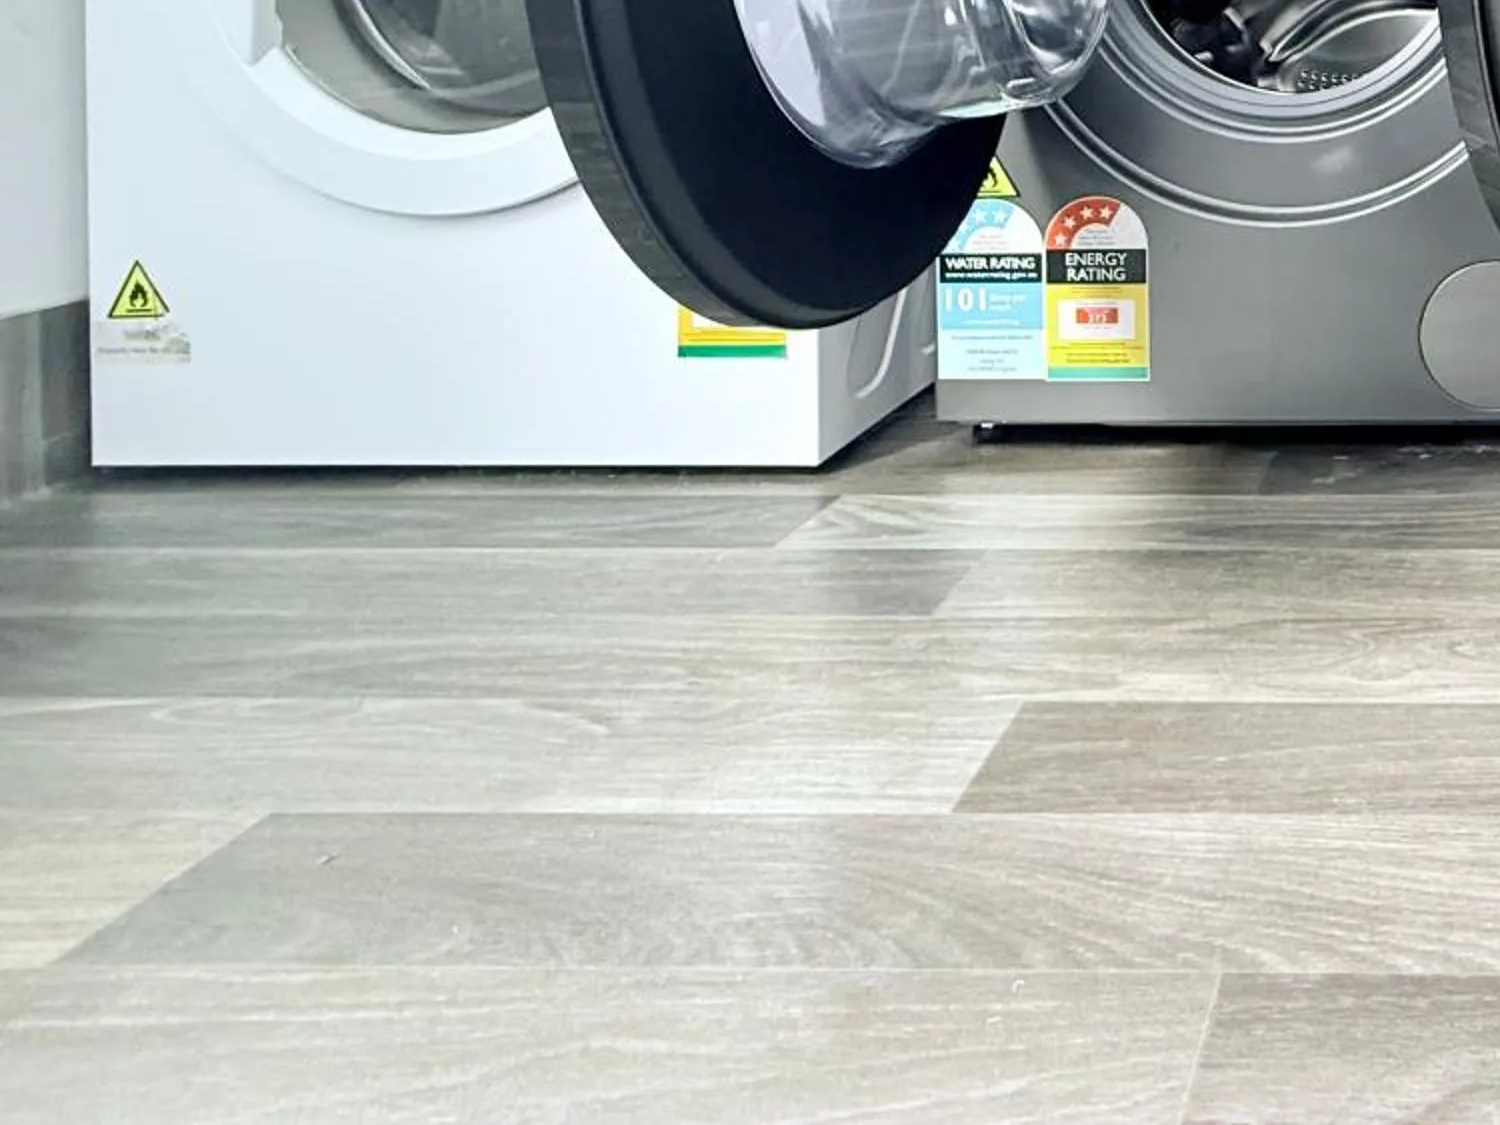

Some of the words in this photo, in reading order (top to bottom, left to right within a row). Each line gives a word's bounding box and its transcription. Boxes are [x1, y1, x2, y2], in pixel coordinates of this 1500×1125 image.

[945, 257, 988, 270] WATER
[990, 257, 1036, 270] RATING
[1065, 252, 1127, 266] ENERGY
[1066, 268, 1126, 281] RATING
[945, 286, 987, 313] 101
